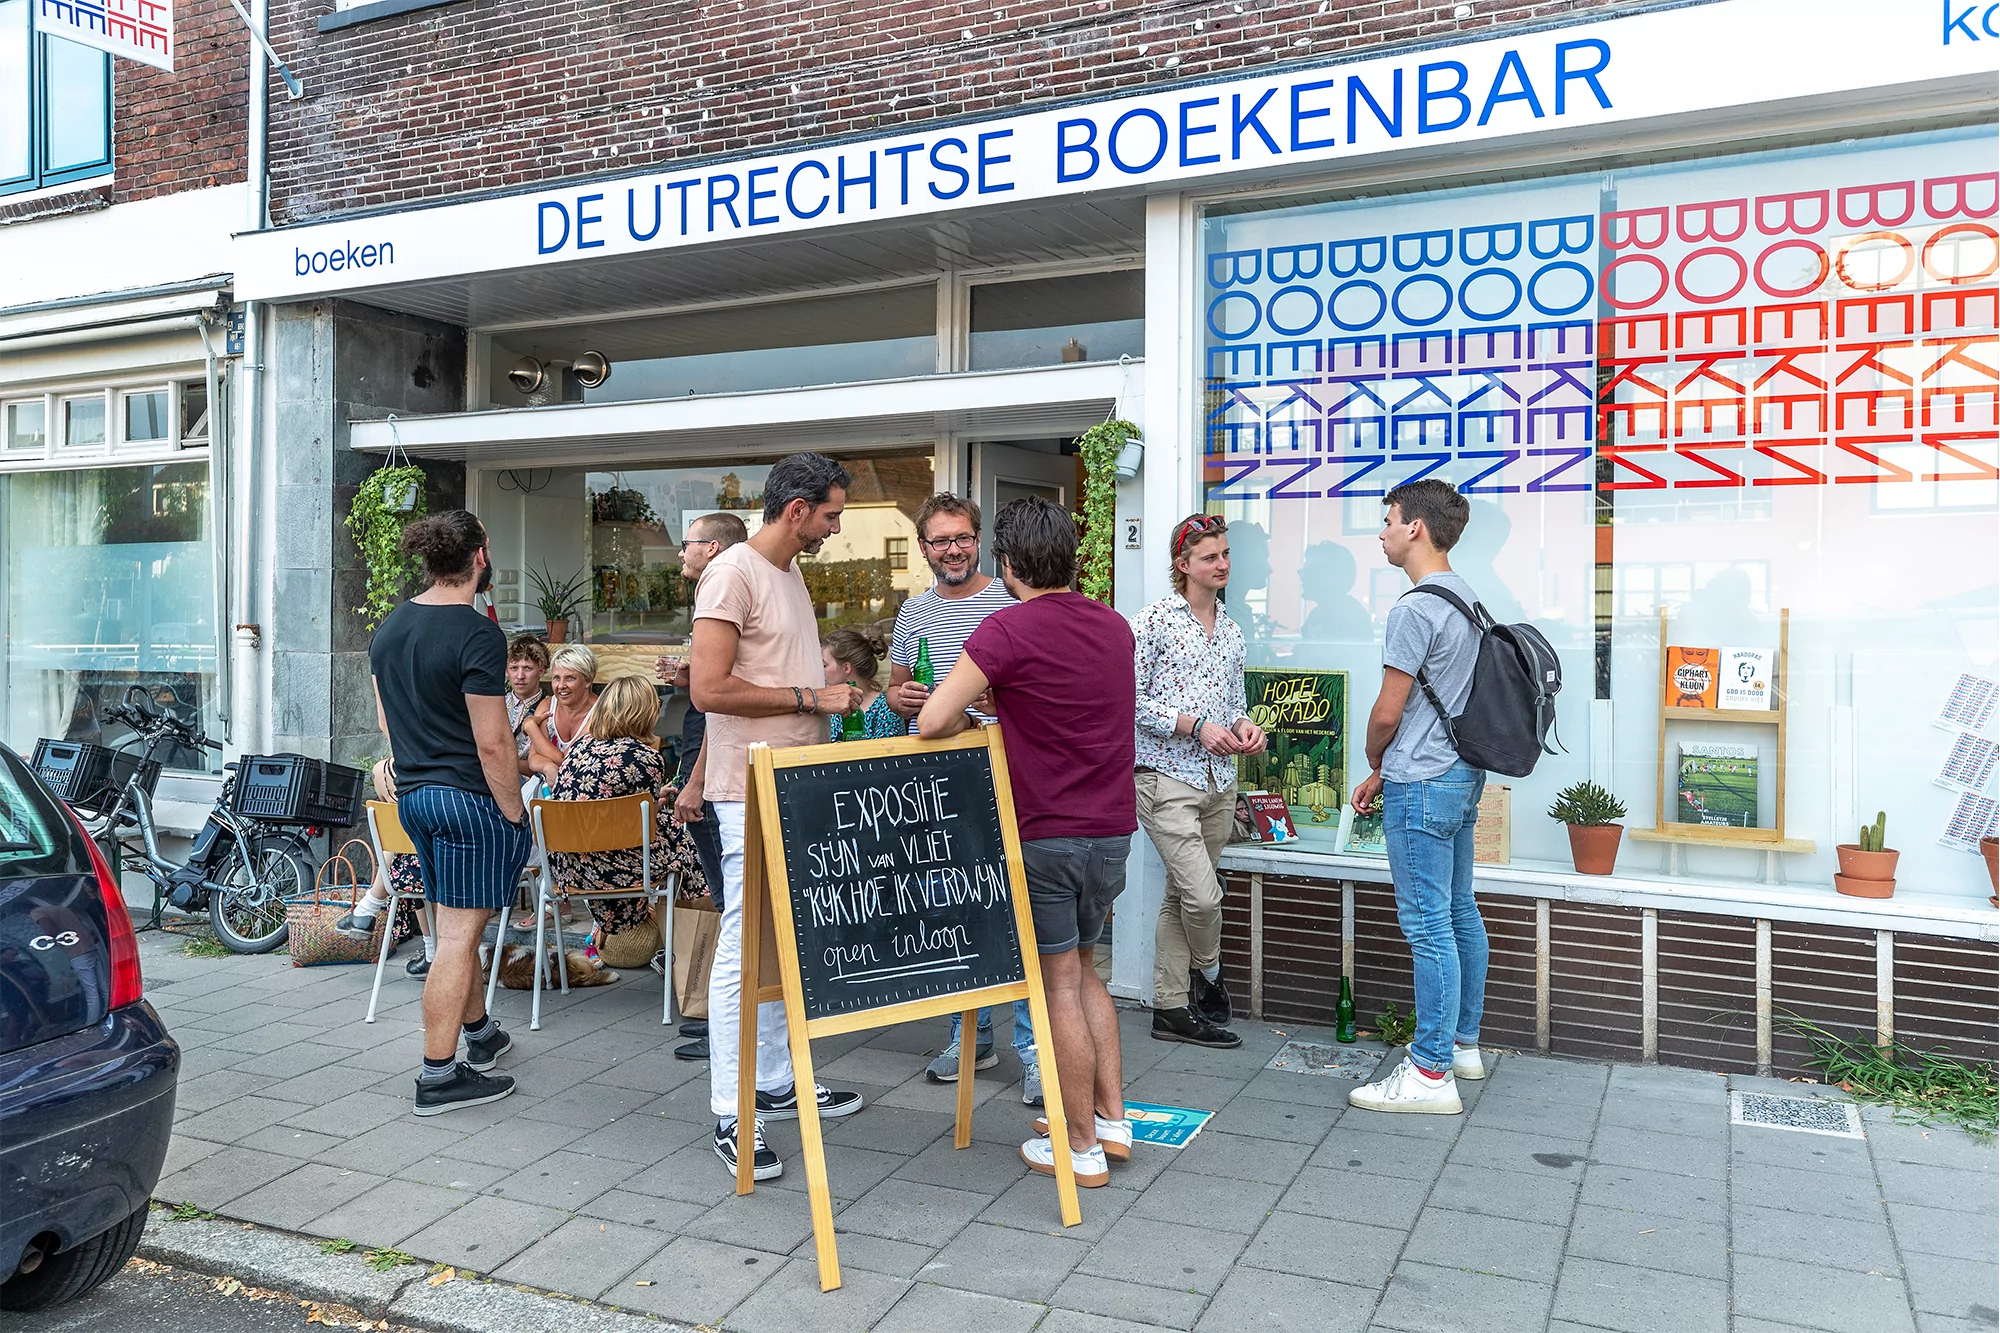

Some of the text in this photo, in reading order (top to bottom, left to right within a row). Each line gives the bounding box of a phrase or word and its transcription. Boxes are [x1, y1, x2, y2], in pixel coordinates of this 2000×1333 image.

[538, 38, 1613, 255] DE UTRECHTSE BOEKENBAR
[294, 240, 393, 276] boeken
[1207, 250, 1262, 500] BOEKEN
[1266, 243, 1323, 499] BOEKEN
[1328, 236, 1387, 498] BOEKEN
[1458, 222, 1523, 494] BOEKEN
[1526, 214, 1595, 493] BOEKEN
[1598, 206, 1670, 490] BOEKEN
[1674, 198, 1748, 488] BOEKEN
[1753, 189, 1830, 485] BOEKEN
[1834, 180, 1916, 484] BOEKEN
[1128, 525, 1138, 542] 2
[1253, 698, 1331, 726] DORADO
[1263, 676, 1321, 702] HOTEL
[1677, 668, 1709, 679] GIPHART
[1692, 744, 1745, 757] SANTOS
[850, 875, 892, 924] HOE
[867, 852, 895, 869] VAN
[28, 930, 80, 951] C3
[823, 920, 972, 977] open inloop
